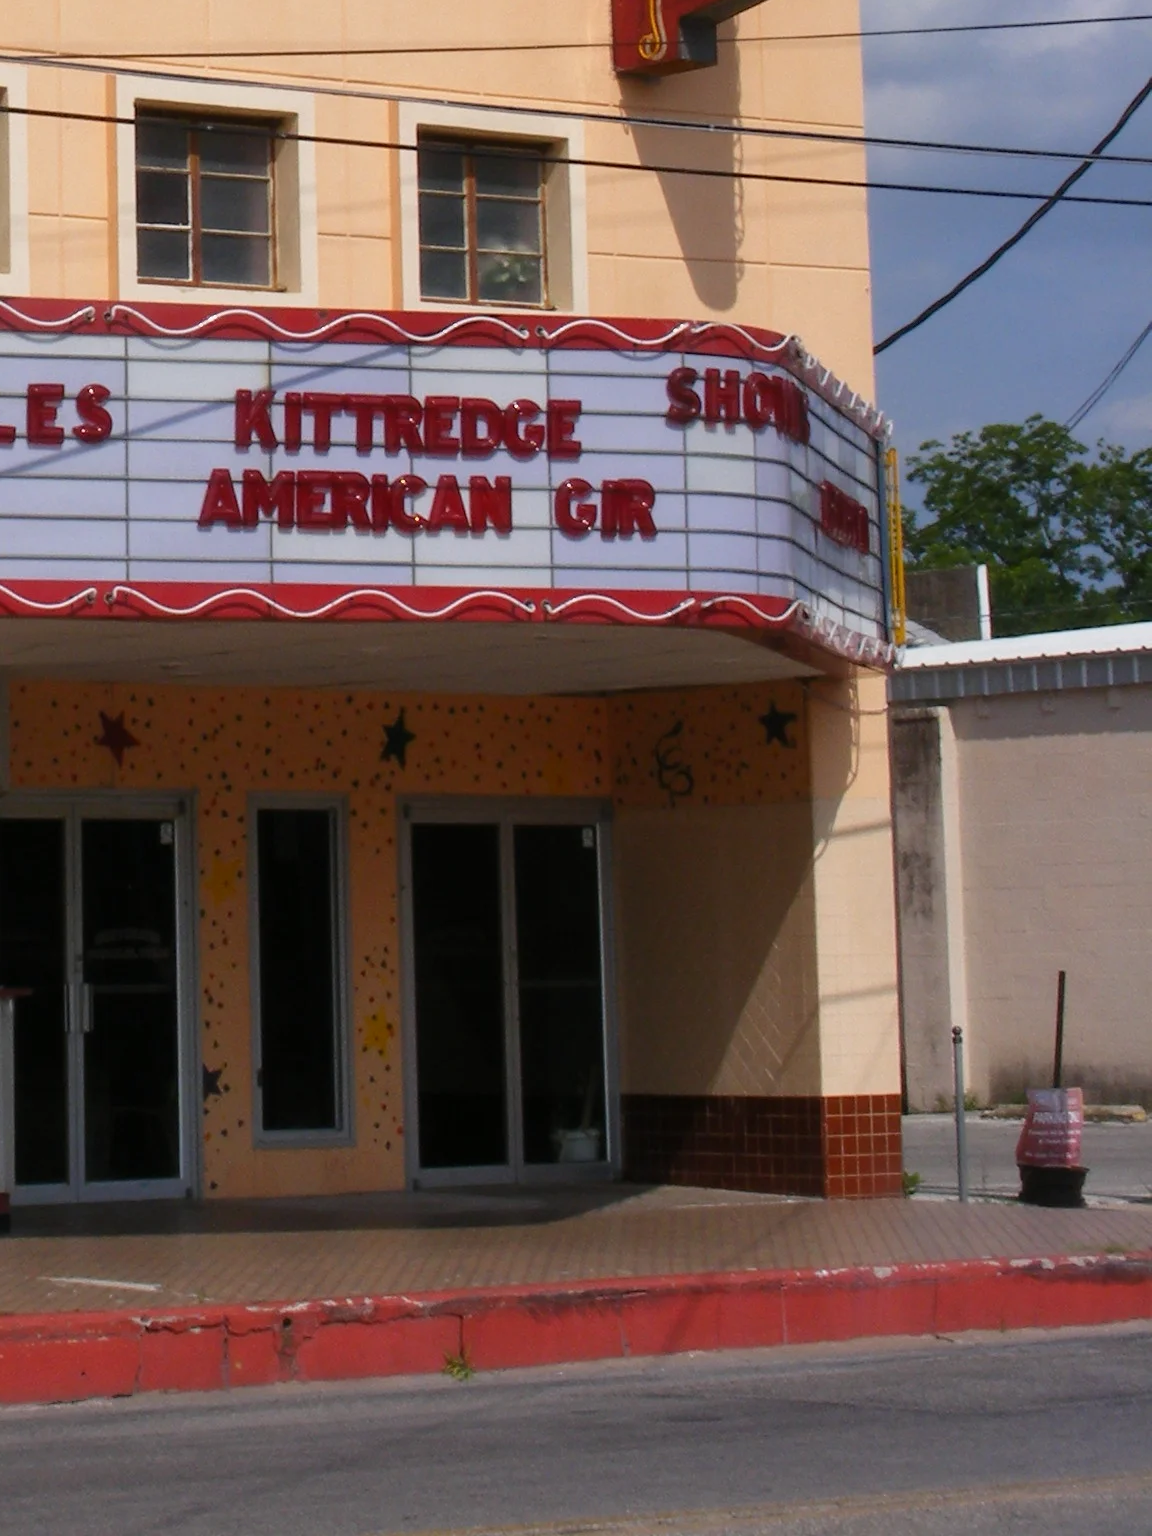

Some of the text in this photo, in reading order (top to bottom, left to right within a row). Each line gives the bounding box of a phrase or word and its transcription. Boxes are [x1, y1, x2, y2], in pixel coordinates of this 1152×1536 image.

[234, 389, 582, 459] KITTREDGE
[197, 467, 658, 538] AMERICAN GIR
